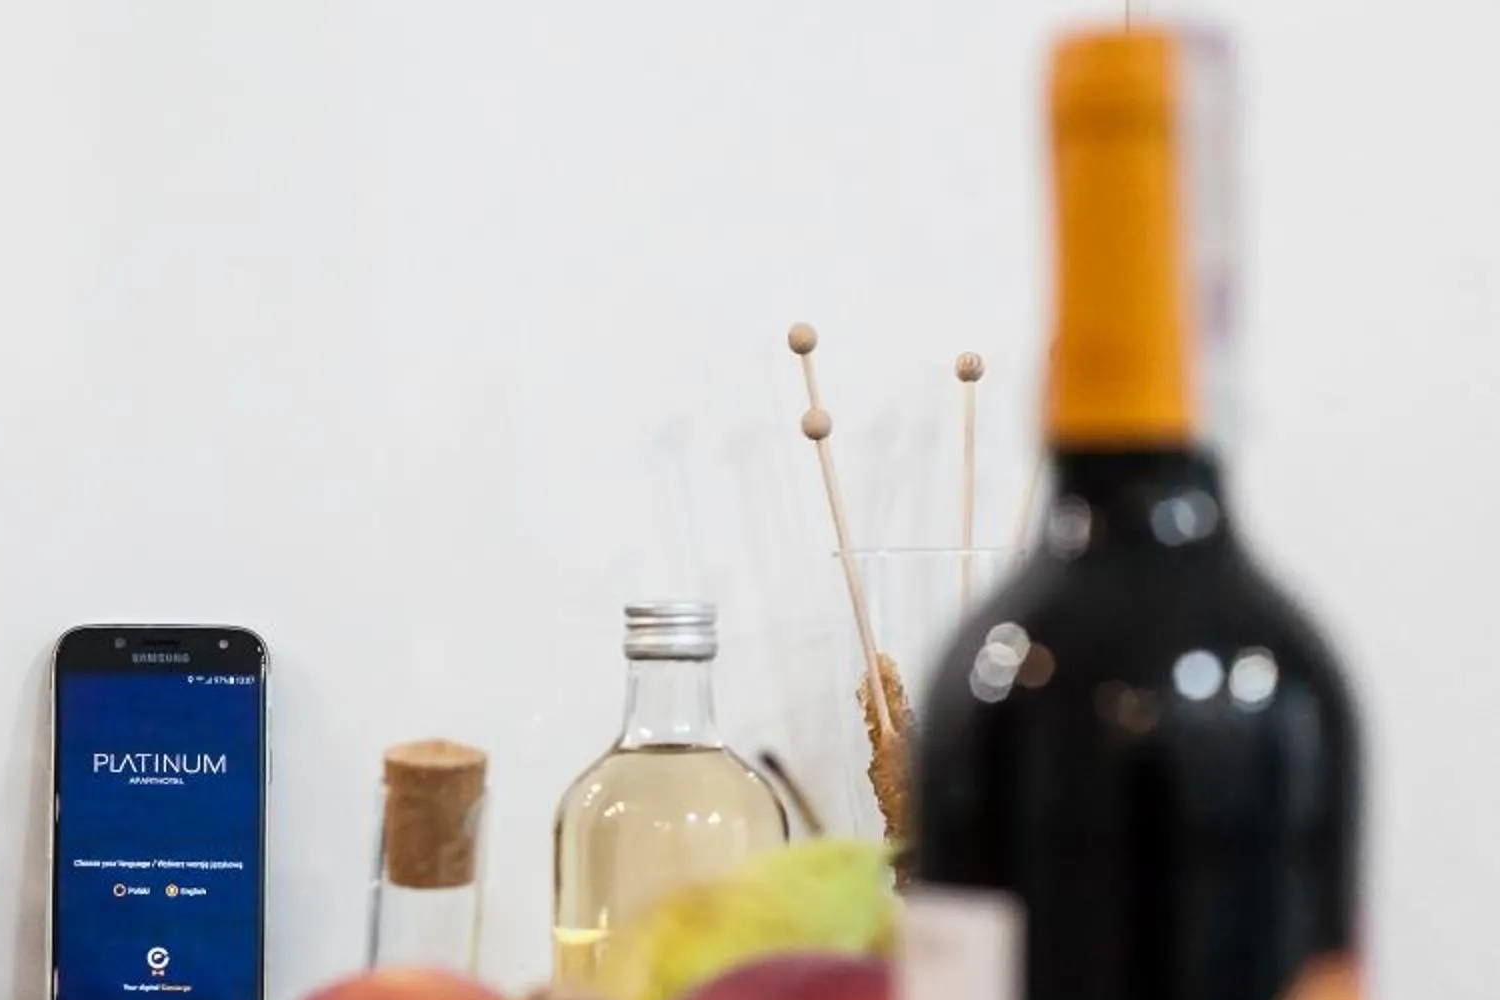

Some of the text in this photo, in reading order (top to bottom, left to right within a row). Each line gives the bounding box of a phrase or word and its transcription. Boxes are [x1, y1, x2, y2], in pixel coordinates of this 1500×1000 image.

[132, 653, 191, 663] SAMSUNG
[93, 753, 226, 774] PLATINUM
[73, 859, 100, 867] Choose
[180, 887, 207, 896] English
